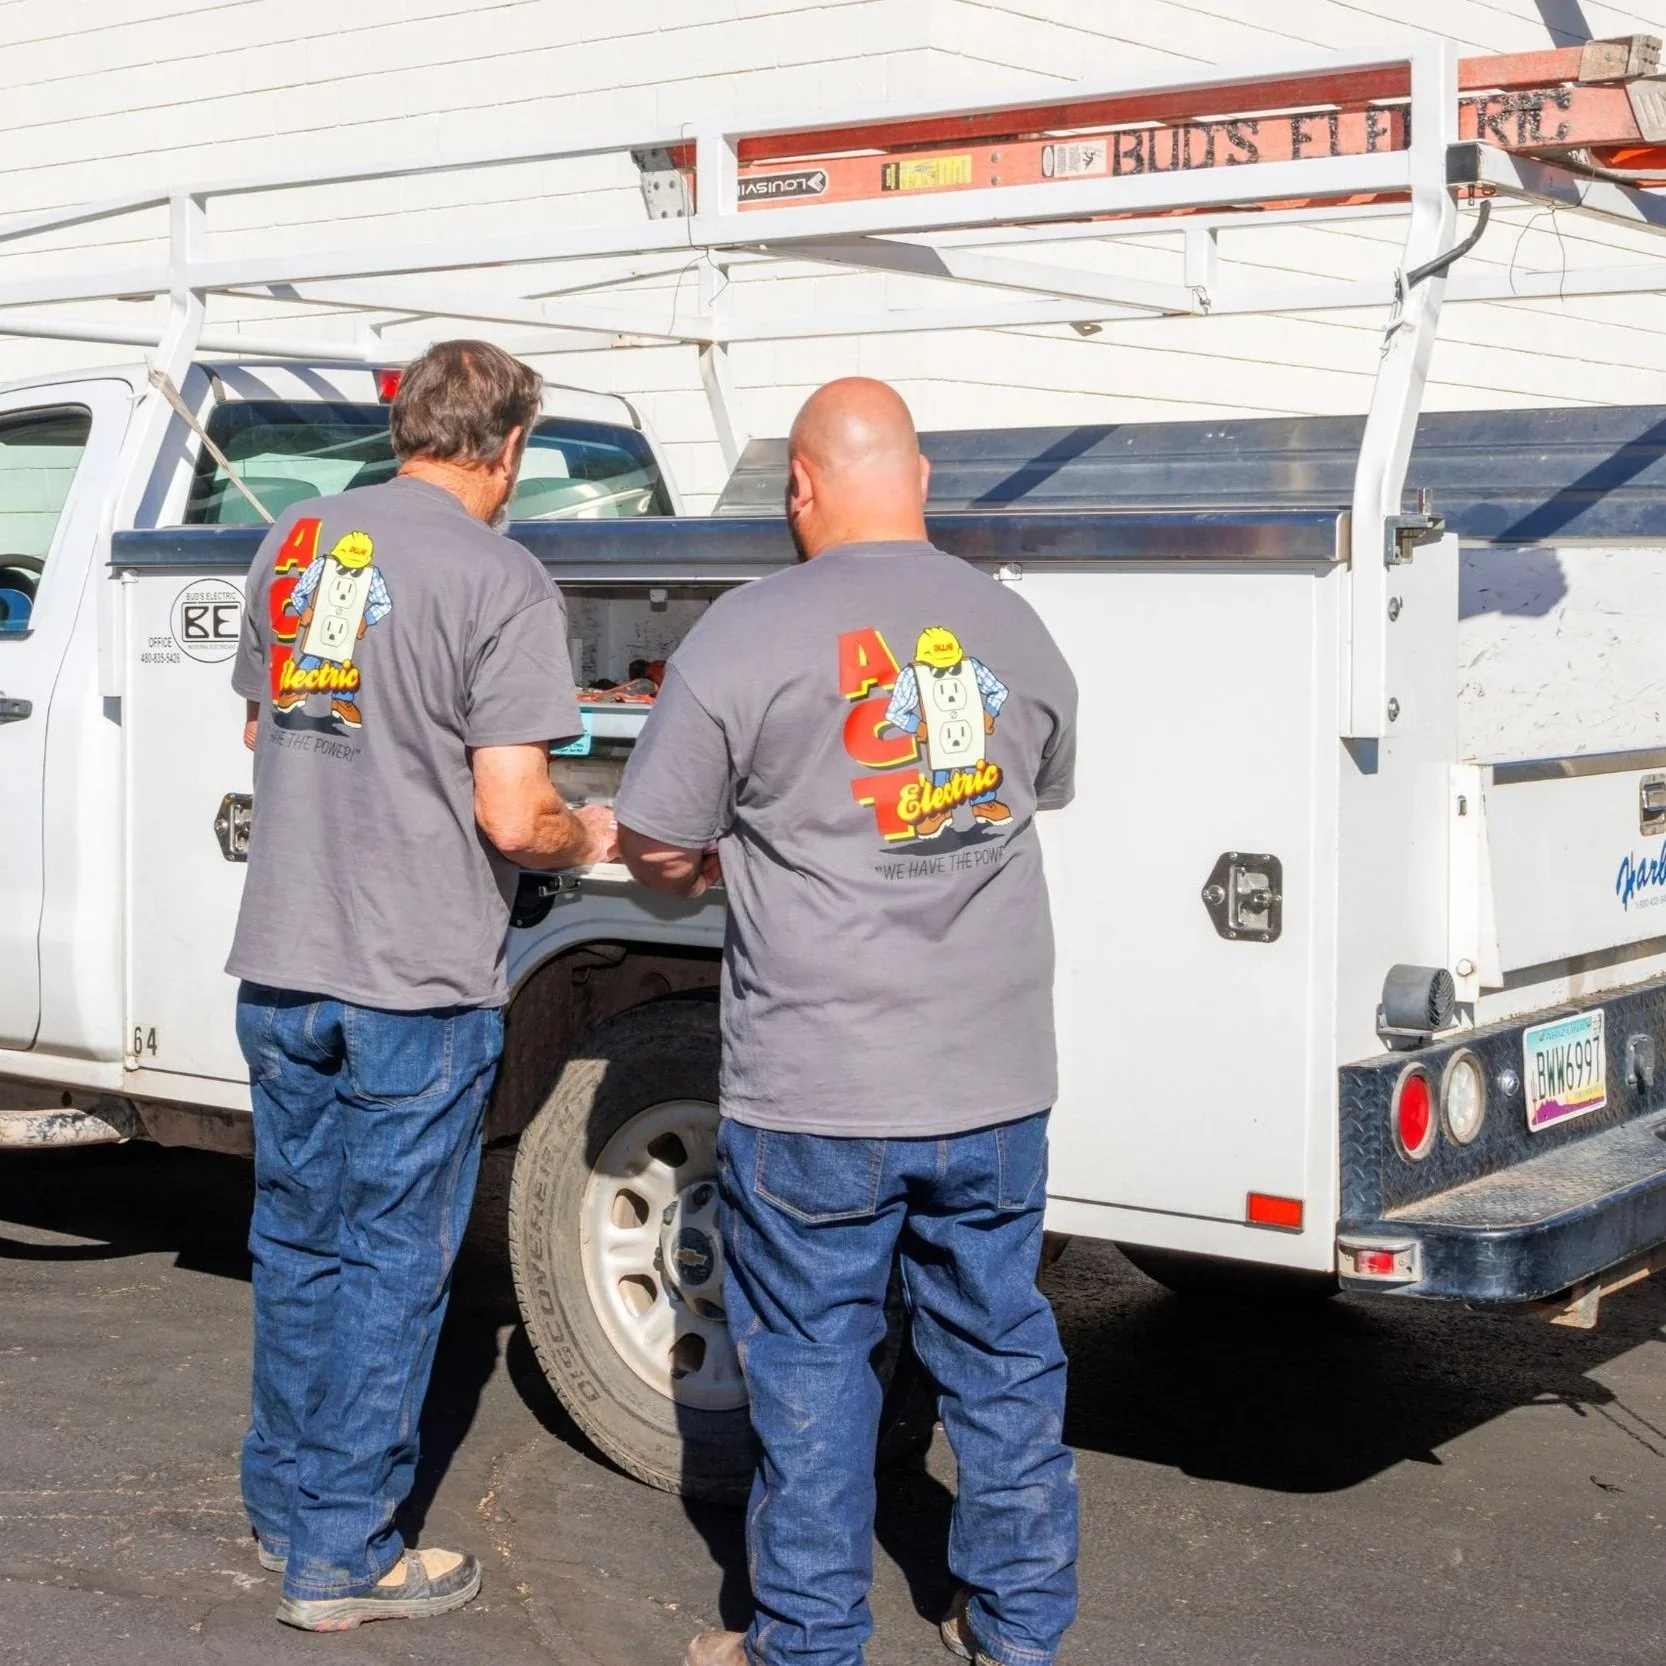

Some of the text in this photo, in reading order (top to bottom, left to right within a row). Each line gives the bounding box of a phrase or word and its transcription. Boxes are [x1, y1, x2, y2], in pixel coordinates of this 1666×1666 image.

[1291, 86, 1572, 160] ELERIC
[206, 592, 237, 600] ELECTRIC
[184, 605, 239, 638] BE
[149, 637, 172, 647] OFFICE
[281, 659, 361, 696] lectric
[287, 733, 313, 751] THE
[897, 758, 1003, 825] Electric
[908, 857, 946, 878] HAVE
[948, 851, 972, 872] THE
[133, 1026, 158, 1056] 64
[1536, 1036, 1601, 1100] BWW6997
